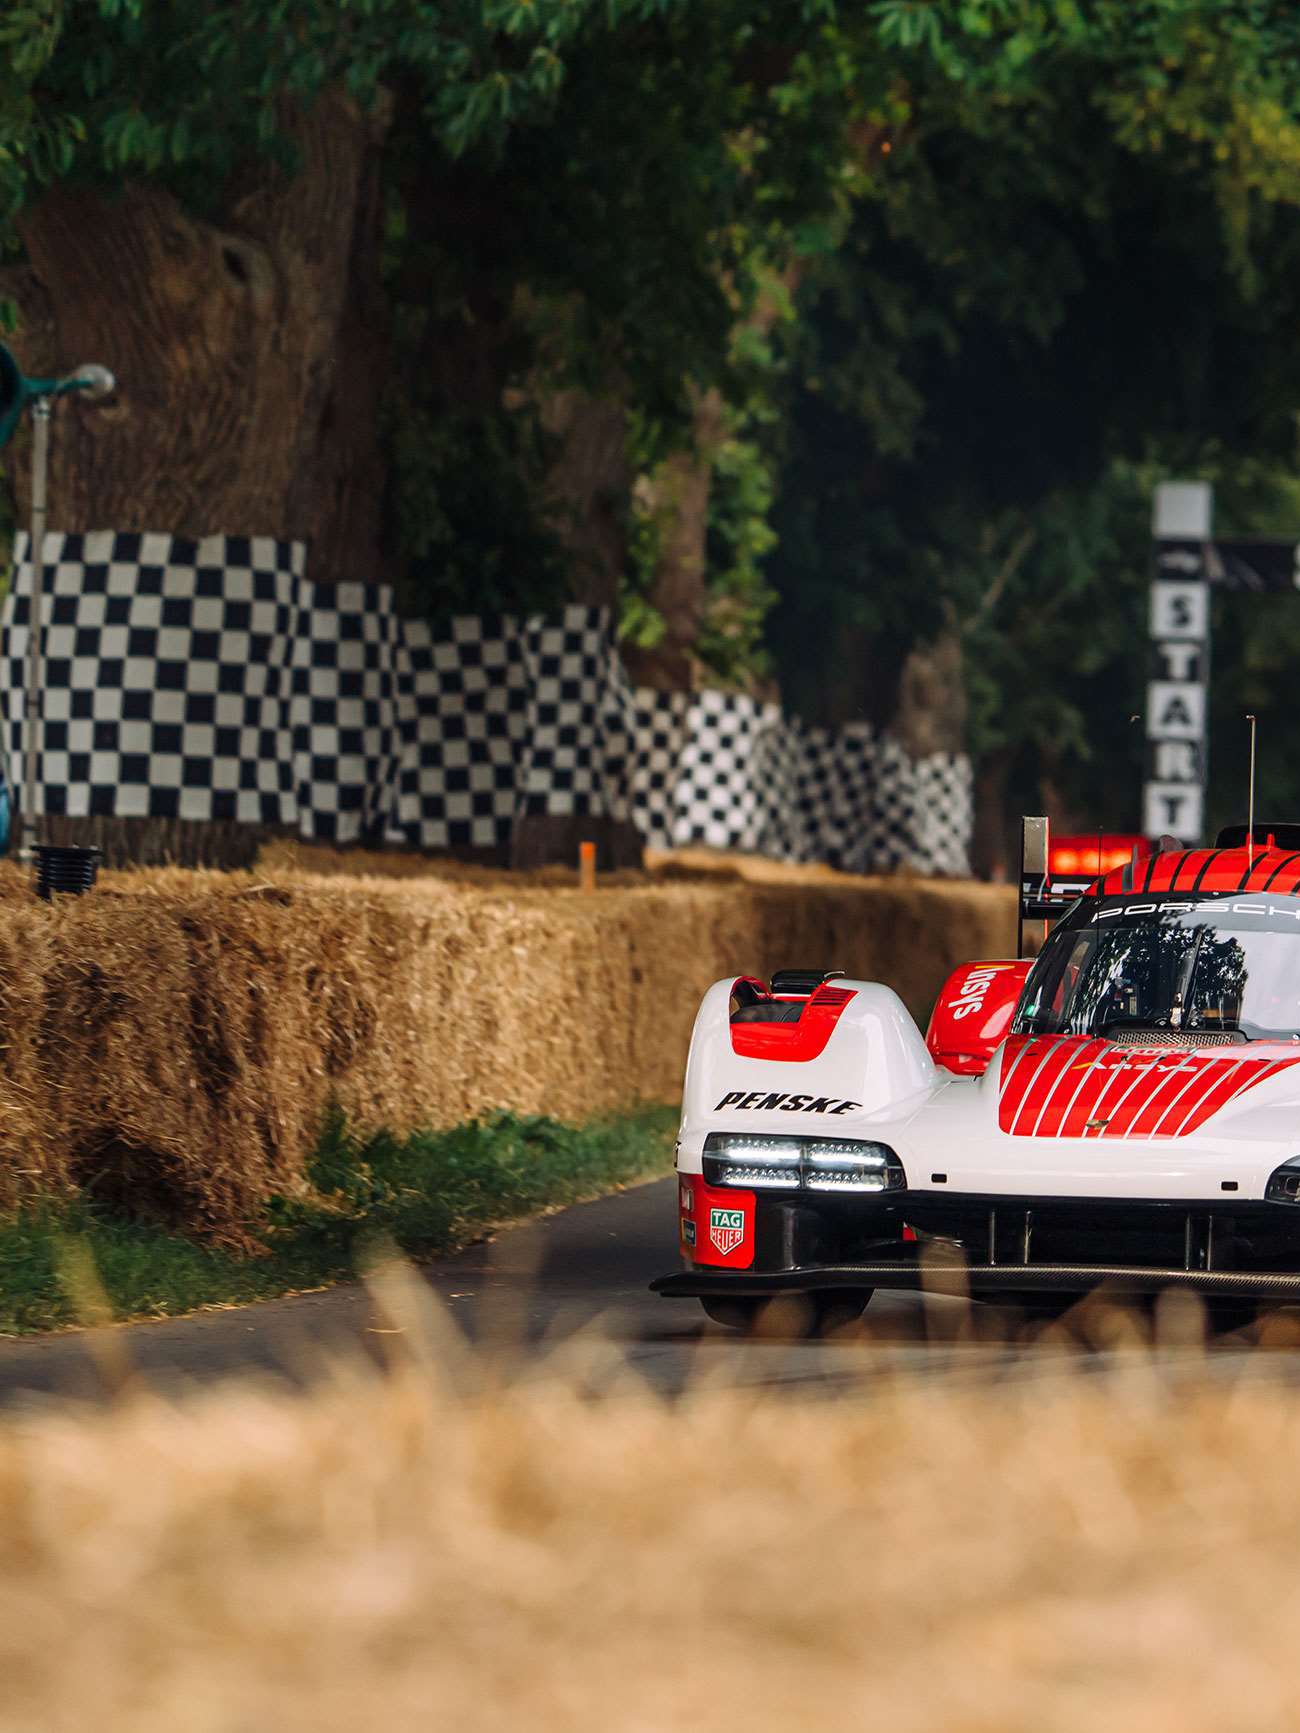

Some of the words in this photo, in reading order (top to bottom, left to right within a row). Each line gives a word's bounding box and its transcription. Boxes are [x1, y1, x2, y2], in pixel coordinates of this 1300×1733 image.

[1157, 594, 1197, 826] START
[713, 1092, 864, 1115] PENSKE
[712, 1212, 741, 1227] TAG
[711, 1229, 742, 1251] HEUER
